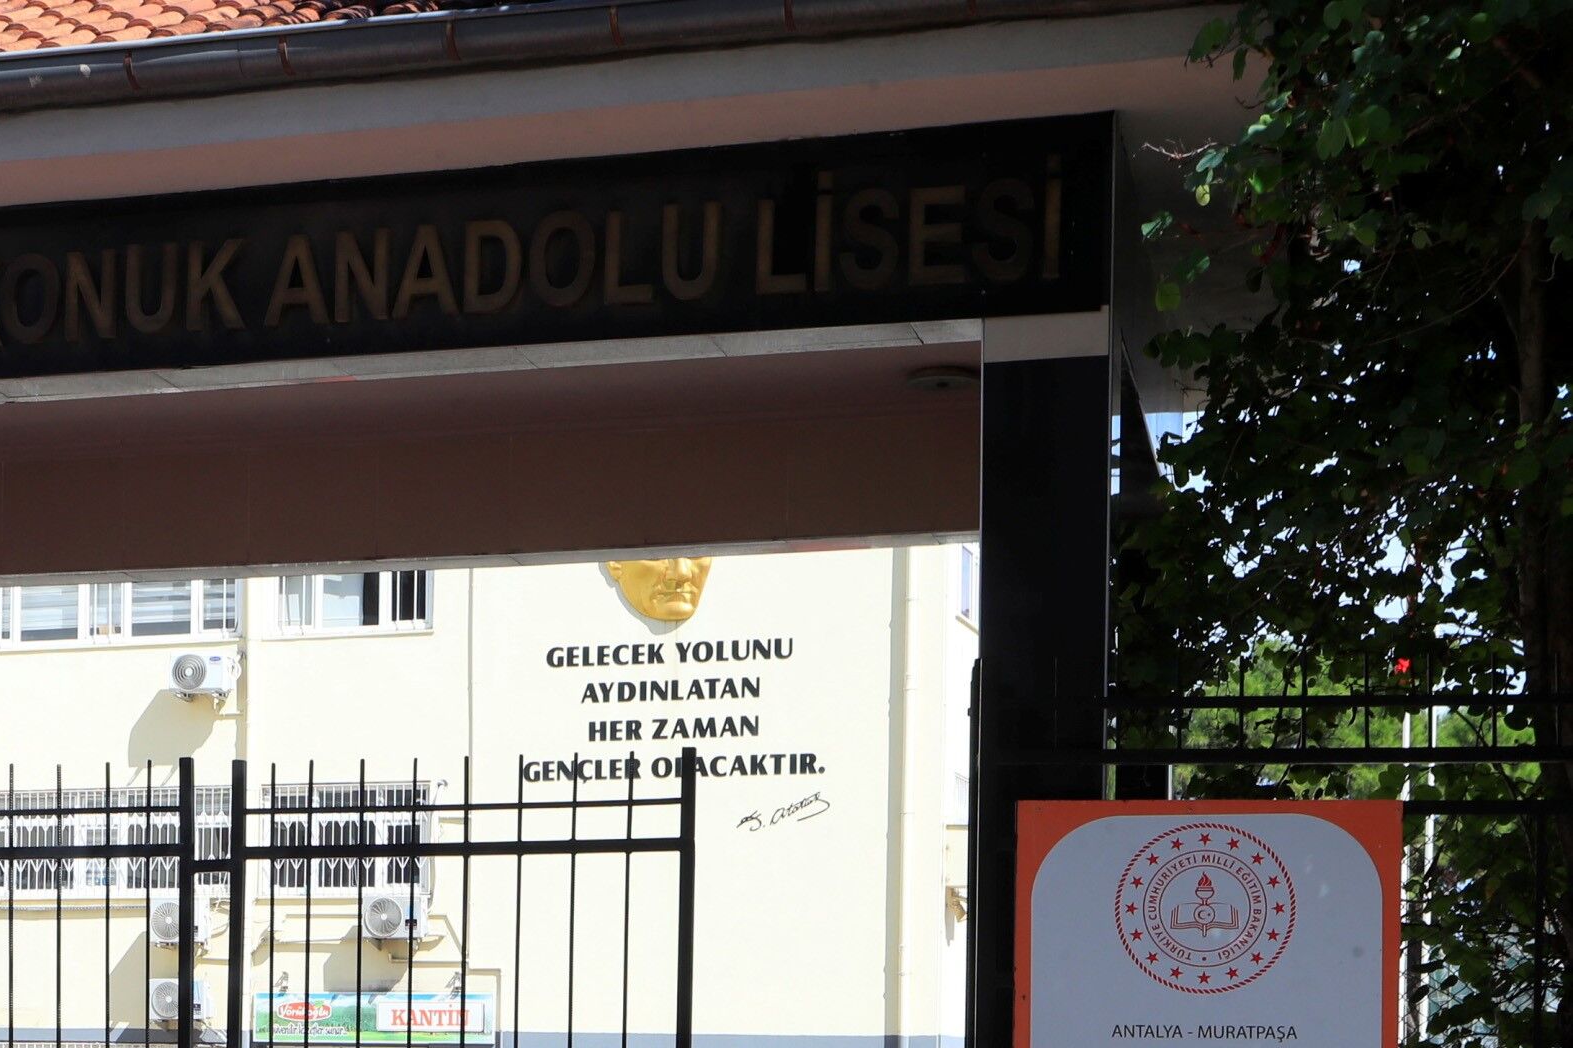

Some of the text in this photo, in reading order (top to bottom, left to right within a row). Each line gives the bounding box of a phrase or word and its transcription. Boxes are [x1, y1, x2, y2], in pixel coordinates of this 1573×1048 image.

[264, 199, 722, 330] ANADOLU
[756, 151, 1062, 297] LİSESİ
[546, 637, 794, 668] GELECEK YOLUNU
[581, 676, 761, 704] AYDINLATAN
[588, 715, 760, 743] HER ZAMAN
[523, 757, 642, 784] GENÇLER
[1147, 852, 1263, 961] TÜRKİYE CUMHURİYETİ MİLLİ EĞİTİM BAKANLIĞI
[391, 1004, 470, 1027] KANTİN
[1111, 1024, 1183, 1039] ANTALYA
[1197, 1025, 1298, 1044] MURATPAŞA
